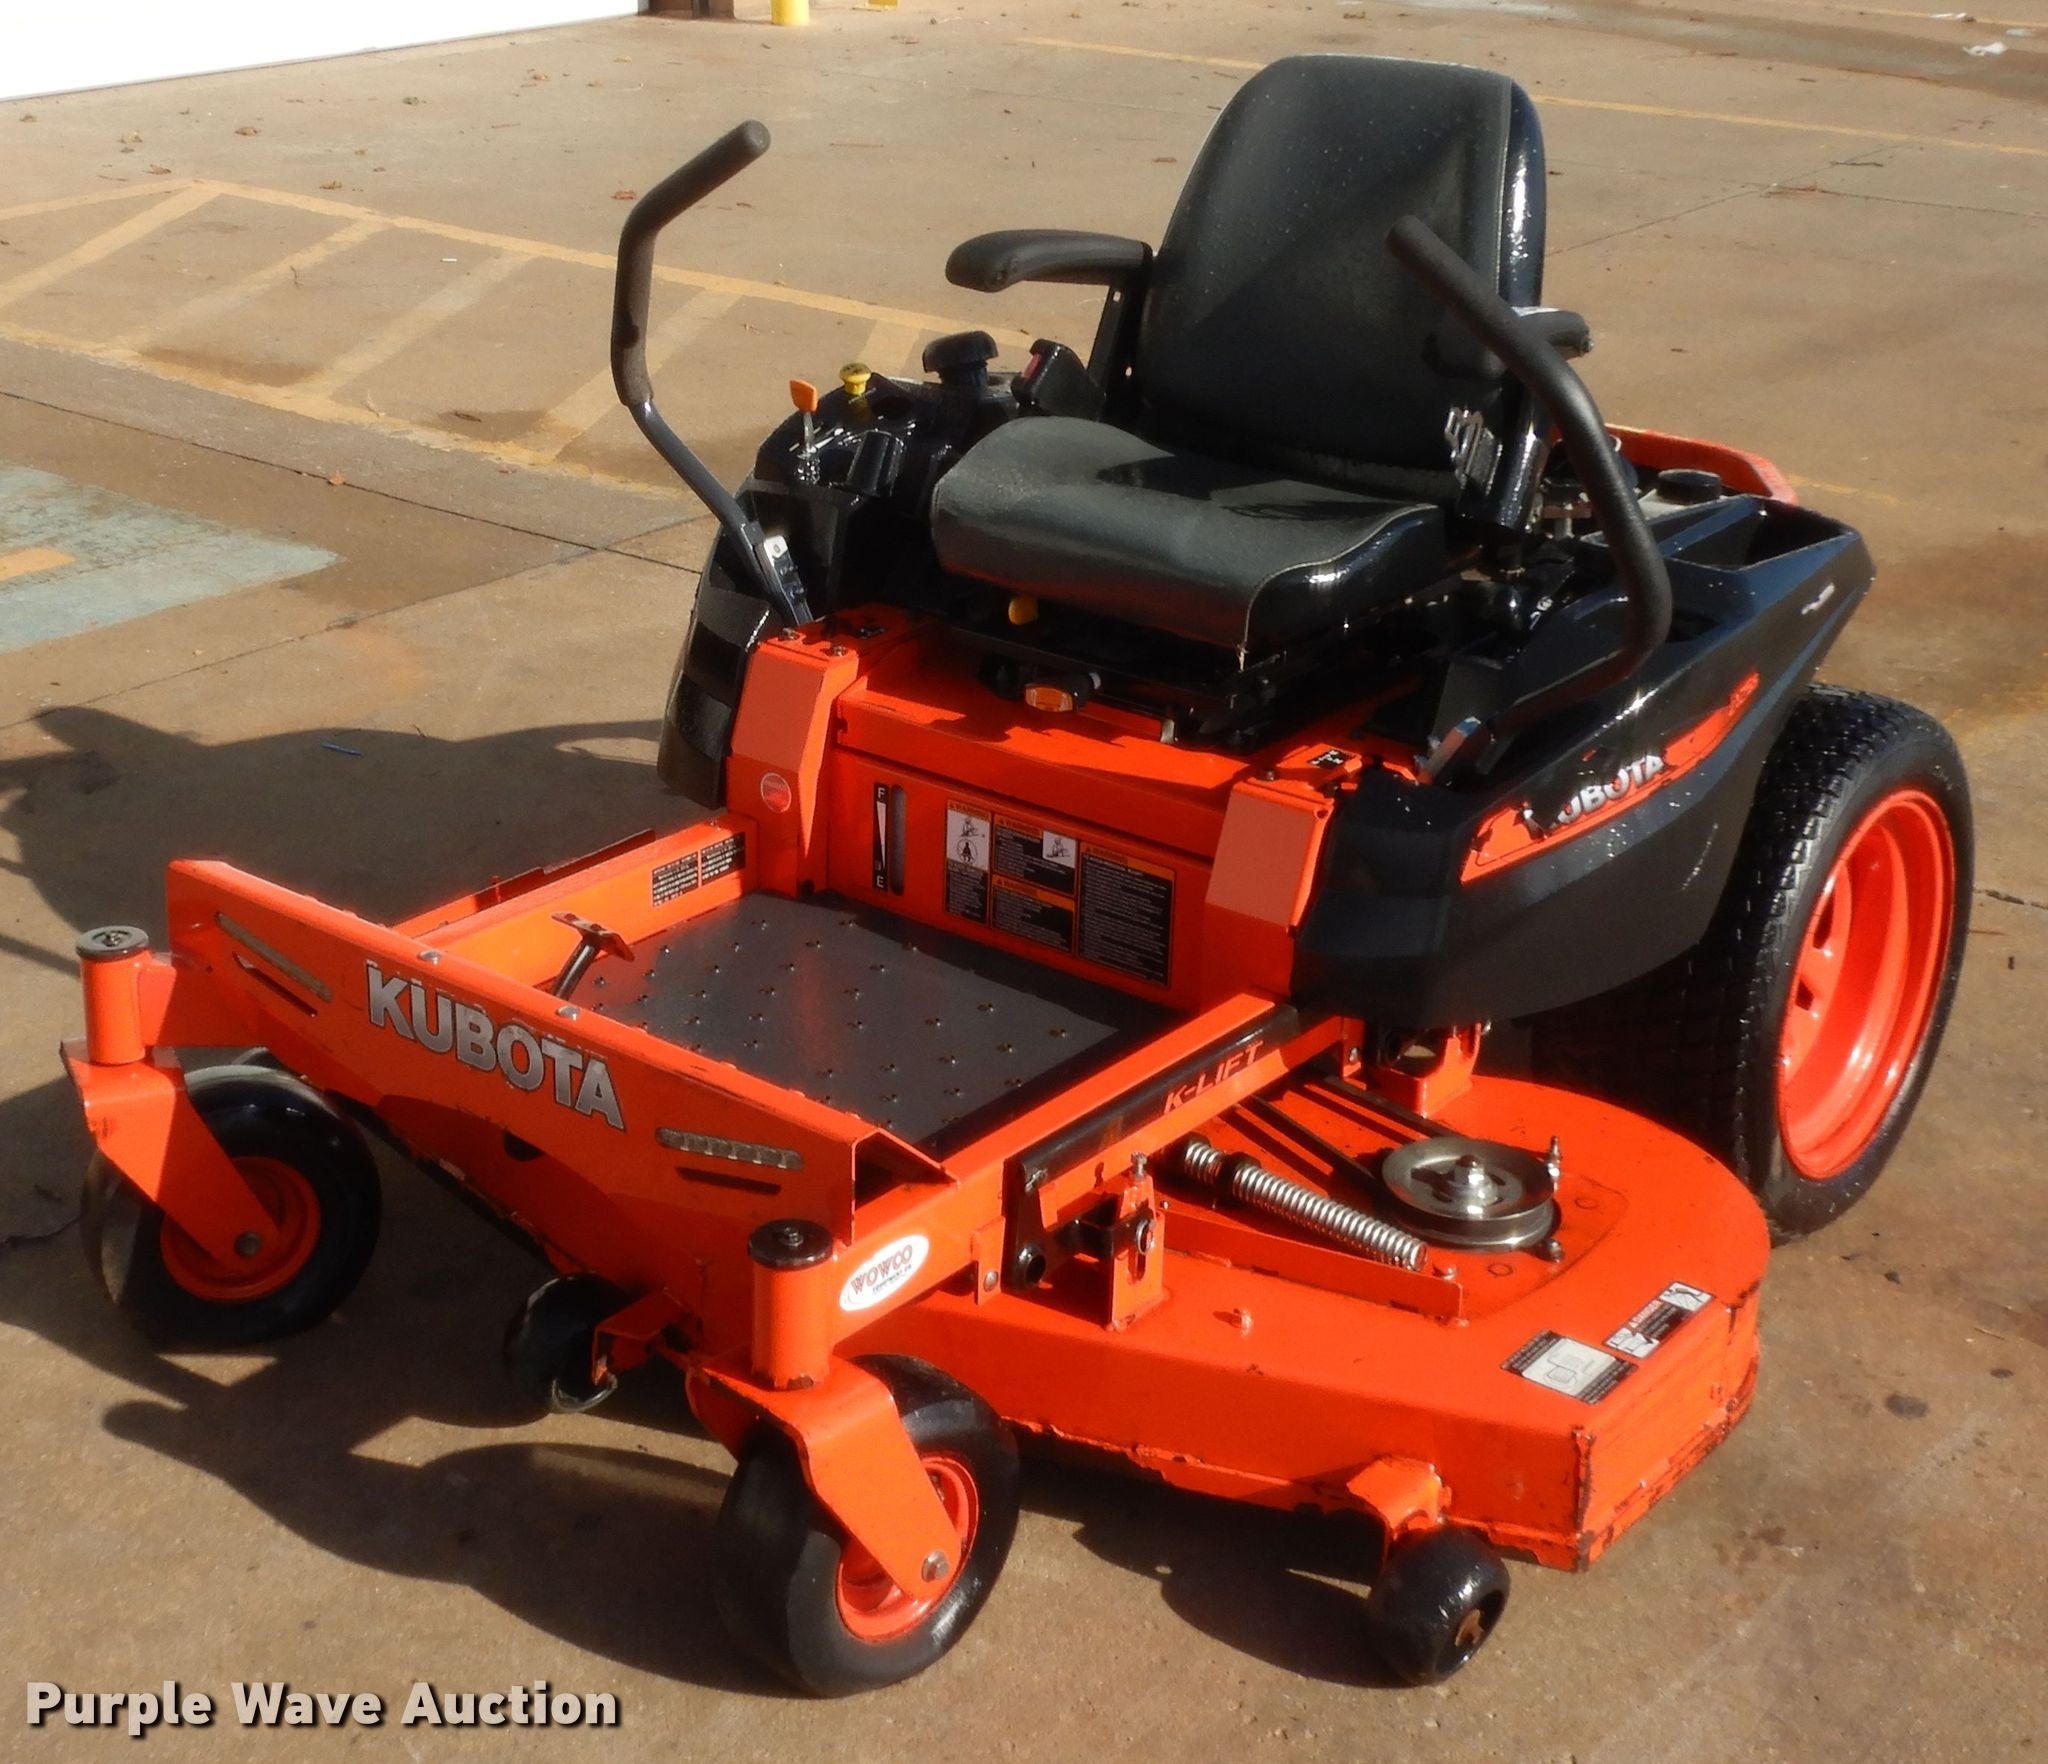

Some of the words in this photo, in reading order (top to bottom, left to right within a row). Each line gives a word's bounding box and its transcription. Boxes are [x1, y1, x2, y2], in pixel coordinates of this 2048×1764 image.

[877, 787, 886, 800] F
[876, 875, 885, 888] E
[365, 963, 625, 1131] KUBOTA
[1163, 1040, 1263, 1115] K-LIFT
